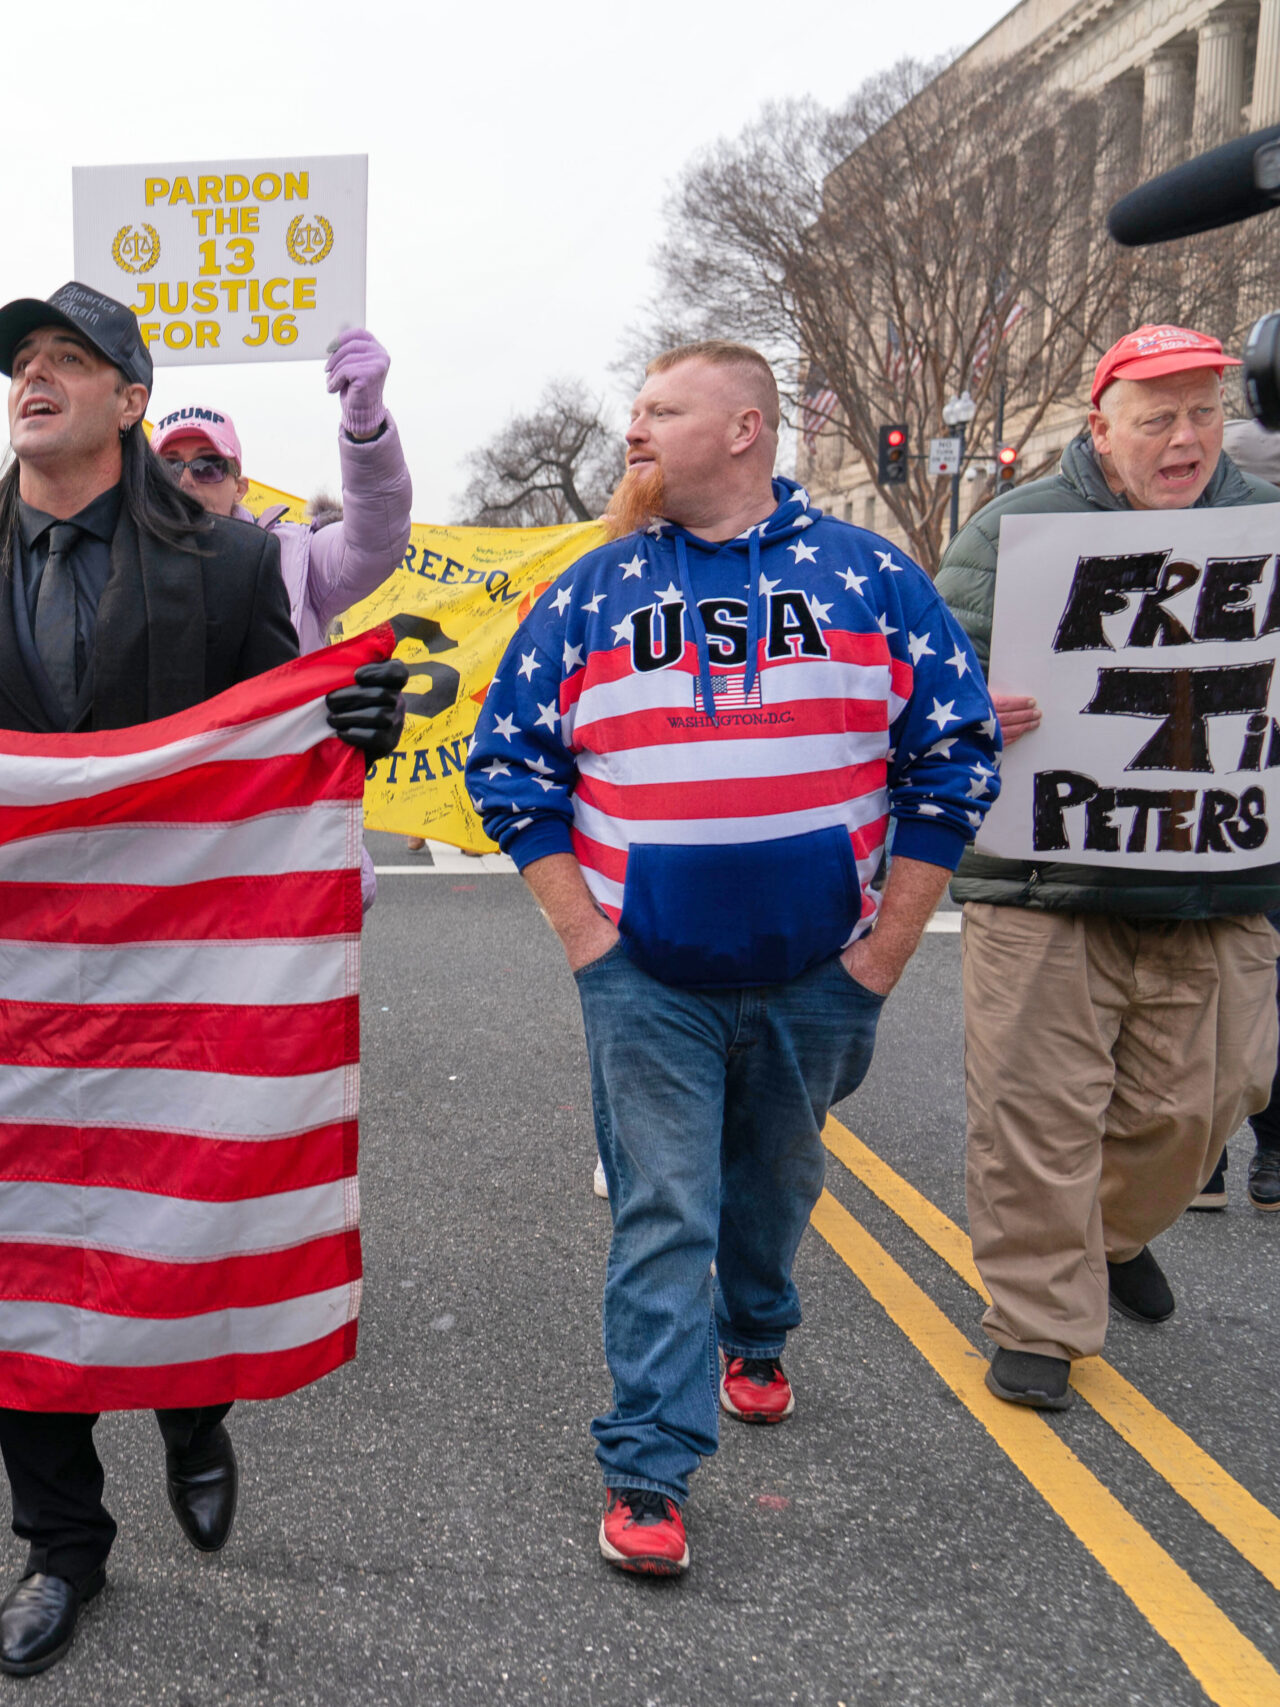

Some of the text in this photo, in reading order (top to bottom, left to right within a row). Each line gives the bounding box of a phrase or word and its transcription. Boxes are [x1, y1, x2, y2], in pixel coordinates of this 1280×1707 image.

[144, 171, 309, 206] PARDON
[192, 206, 260, 236] THE
[198, 238, 256, 277] 13
[62, 285, 119, 314] America
[128, 277, 317, 316] JUSTICE
[140, 314, 299, 350] FOR J6
[159, 407, 225, 430] TRUMP
[1051, 548, 1280, 653] FRE
[629, 589, 831, 674] USA
[366, 733, 473, 784] TAN
[1033, 769, 1269, 854] PETERS
